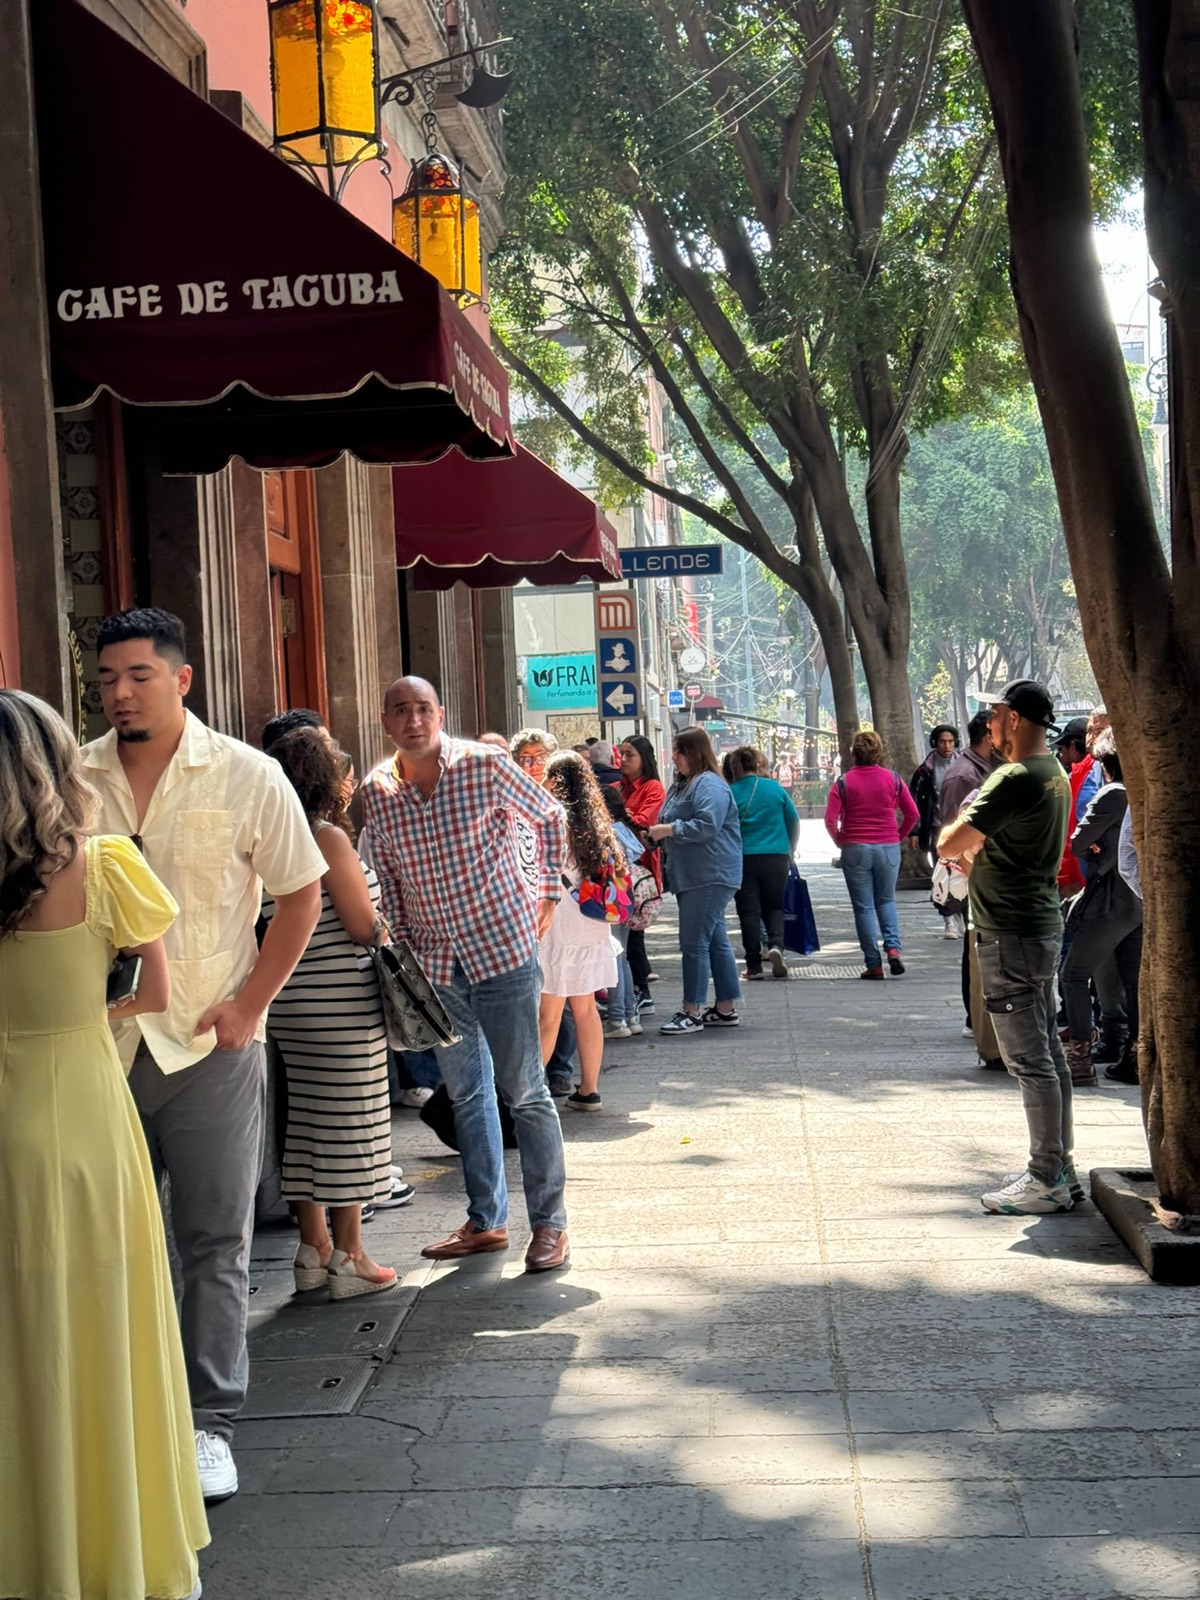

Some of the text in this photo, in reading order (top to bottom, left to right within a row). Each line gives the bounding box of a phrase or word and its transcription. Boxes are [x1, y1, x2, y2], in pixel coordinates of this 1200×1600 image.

[57, 270, 404, 322] CAFE DE TACUBA
